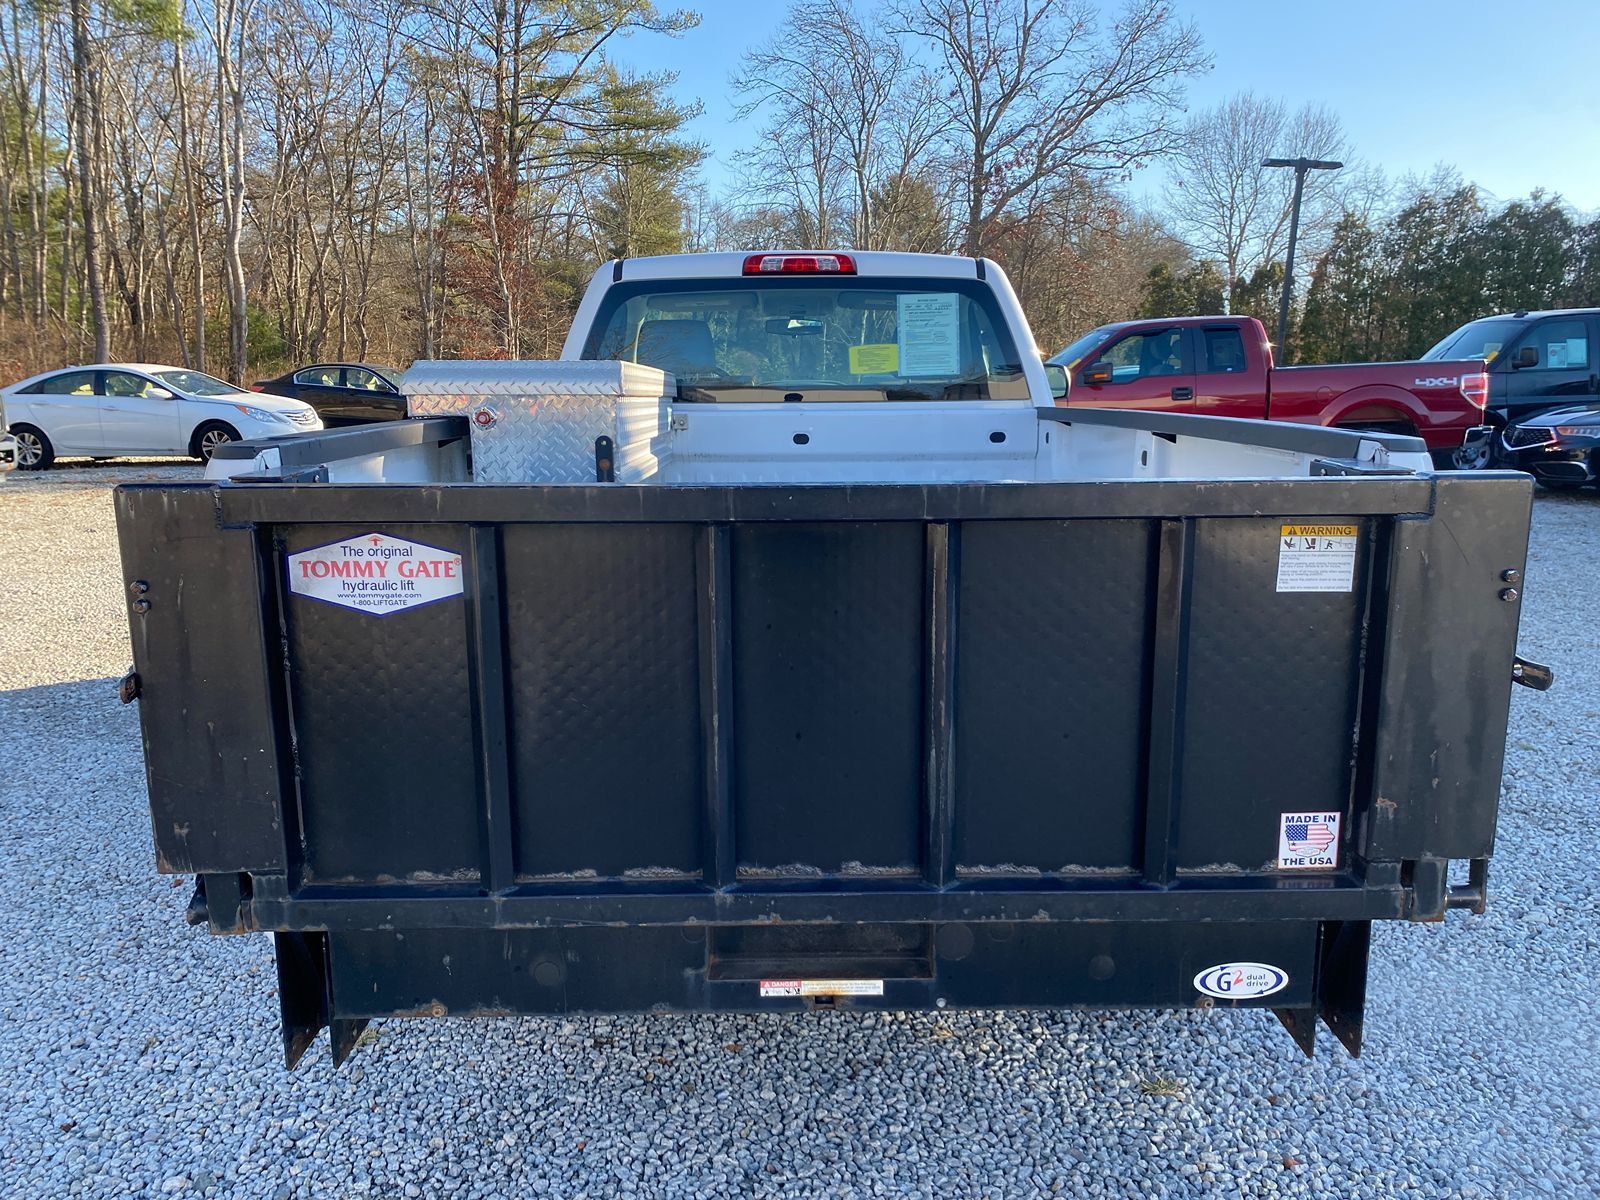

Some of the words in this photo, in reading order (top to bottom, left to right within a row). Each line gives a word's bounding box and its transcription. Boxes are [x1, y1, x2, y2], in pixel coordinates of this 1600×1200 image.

[1300, 526, 1352, 535] WARNING
[340, 546, 364, 557] The
[367, 546, 413, 559] original
[299, 560, 388, 578] TOMMY
[342, 580, 398, 592] hydraulic
[400, 580, 415, 591] lift
[1285, 815, 1319, 823] MADE
[1323, 815, 1336, 823] IN
[1282, 858, 1306, 866] THE
[1309, 857, 1333, 865] USA
[1246, 979, 1269, 987] drive
